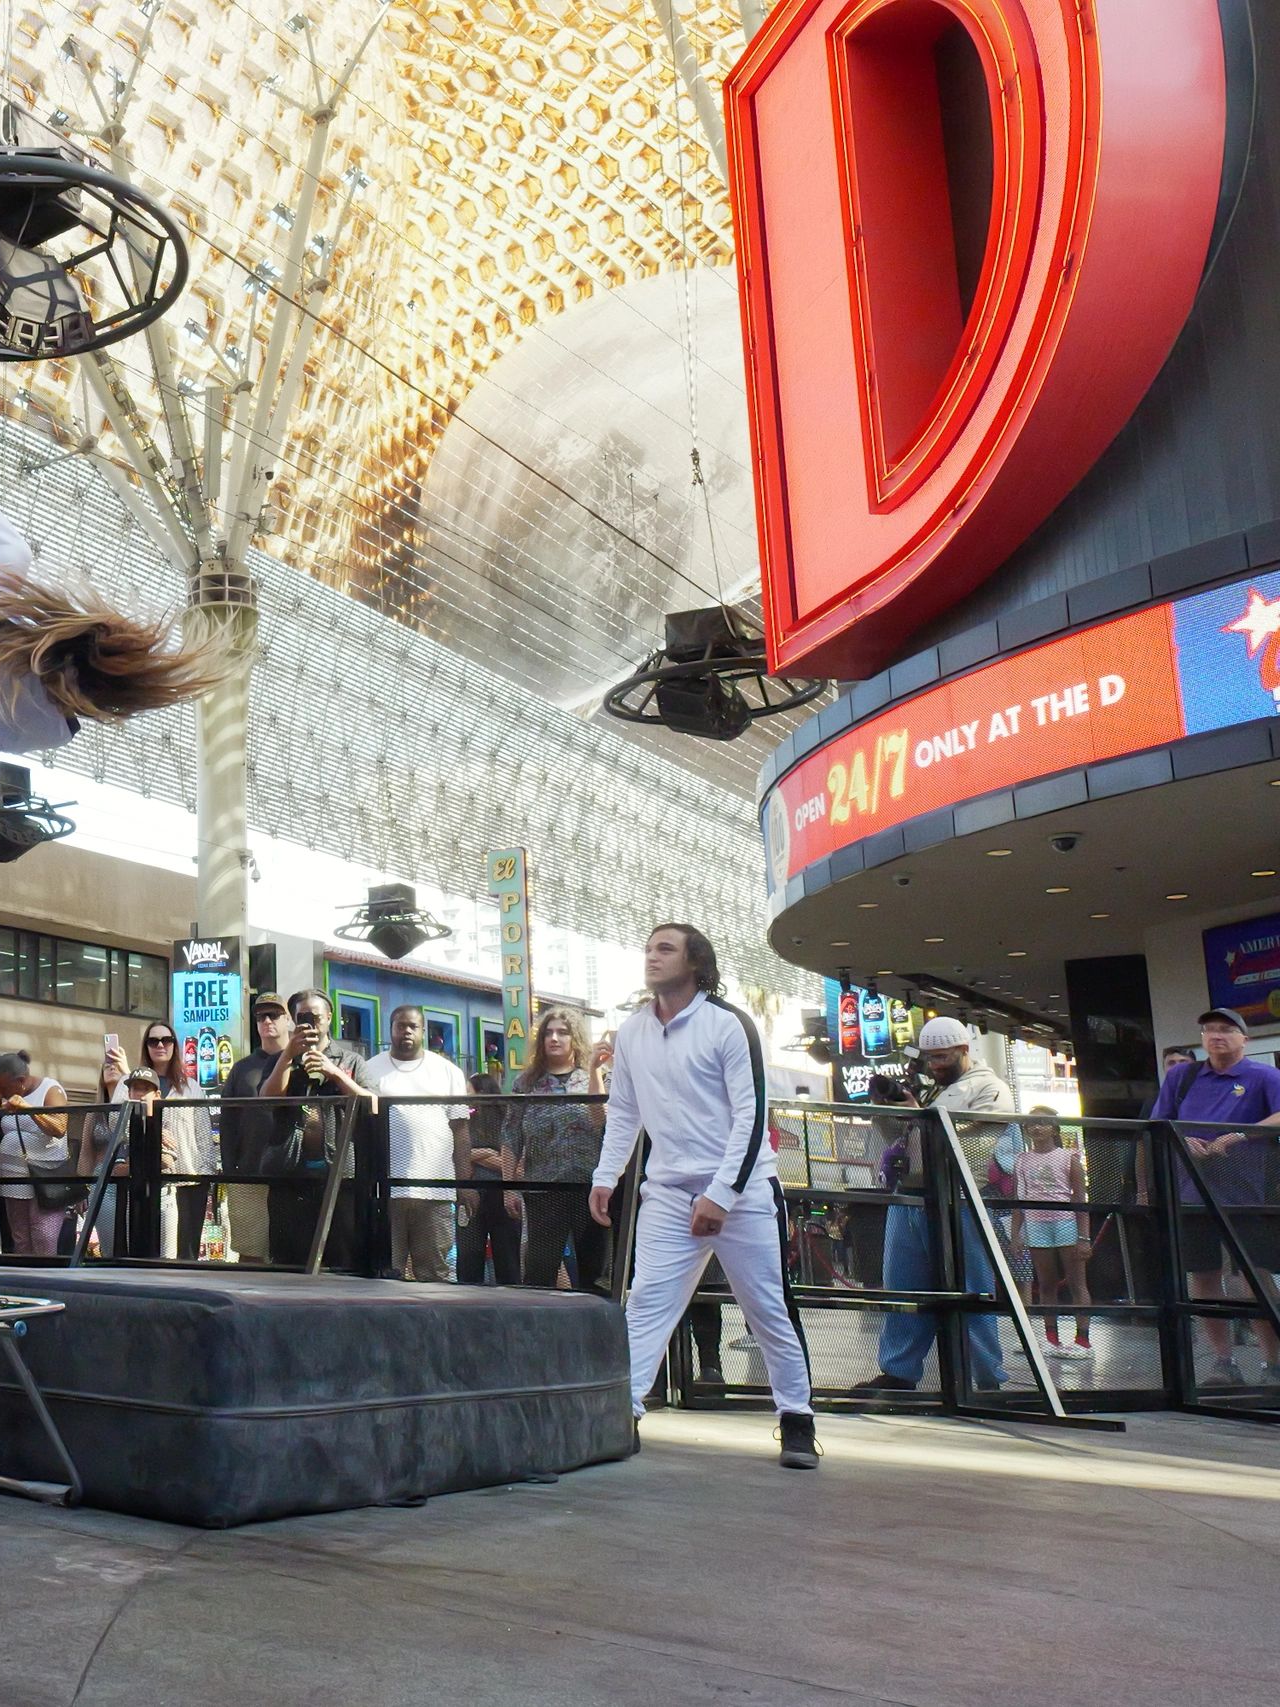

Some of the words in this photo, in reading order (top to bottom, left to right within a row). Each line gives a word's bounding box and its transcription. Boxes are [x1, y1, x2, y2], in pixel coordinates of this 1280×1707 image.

[723, 0, 1110, 678] D
[794, 792, 826, 832] OPEN
[826, 727, 909, 827] 24/7
[914, 719, 980, 769] ONLY
[987, 704, 1022, 743] AT
[1030, 682, 1090, 727] THE
[1098, 674, 1127, 707] D
[492, 856, 517, 882] El
[182, 940, 230, 965] VANDAL
[1239, 933, 1280, 955] AMERI
[501, 891, 528, 1071] PORTAL
[183, 979, 229, 1009] FREE
[183, 1007, 230, 1024] SAMPLES!
[842, 1065, 875, 1081] MADE
[874, 1063, 904, 1077] WITH
[843, 1080, 871, 1095] VOD
